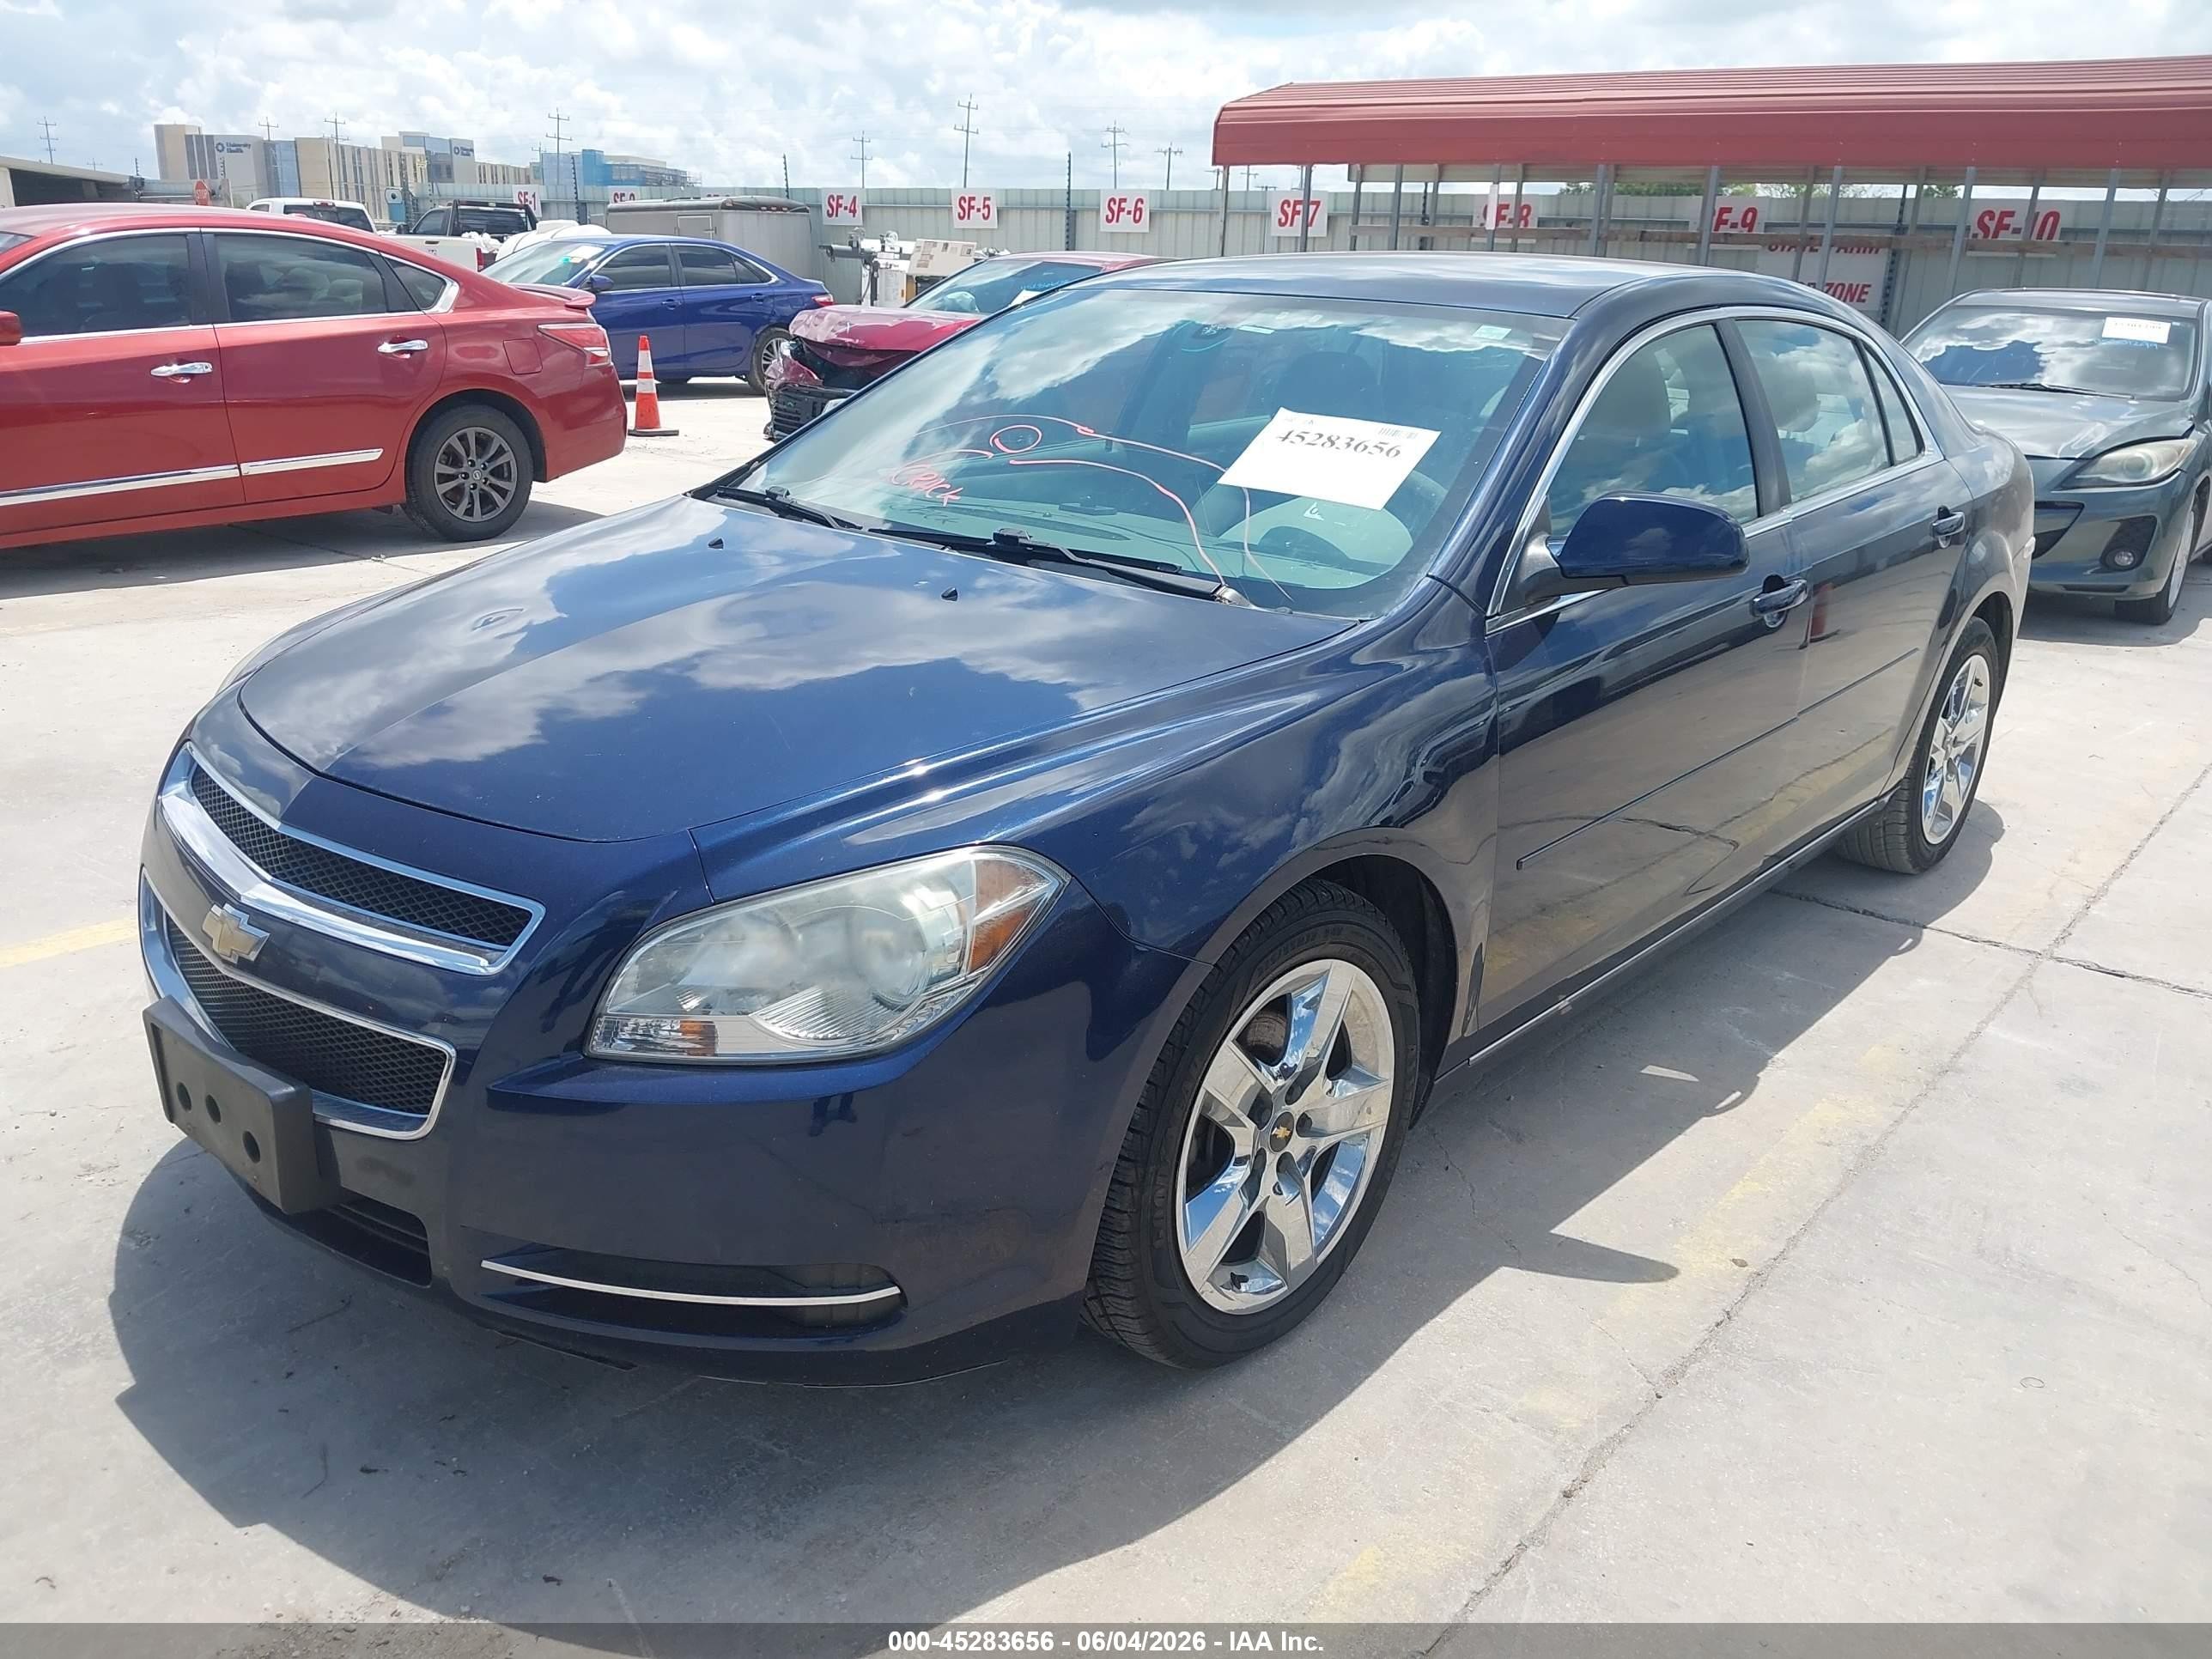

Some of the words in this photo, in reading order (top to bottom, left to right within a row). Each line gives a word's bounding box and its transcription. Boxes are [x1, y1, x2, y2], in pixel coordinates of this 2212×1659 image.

[826, 194, 857, 218] SF-4
[957, 196, 991, 220] SF-5
[1105, 198, 1145, 223] SF-6
[1278, 199, 1321, 228] SF7
[1483, 204, 1532, 228] F-8
[1711, 206, 1759, 232] F-9
[1277, 429, 1402, 459] 45283656
